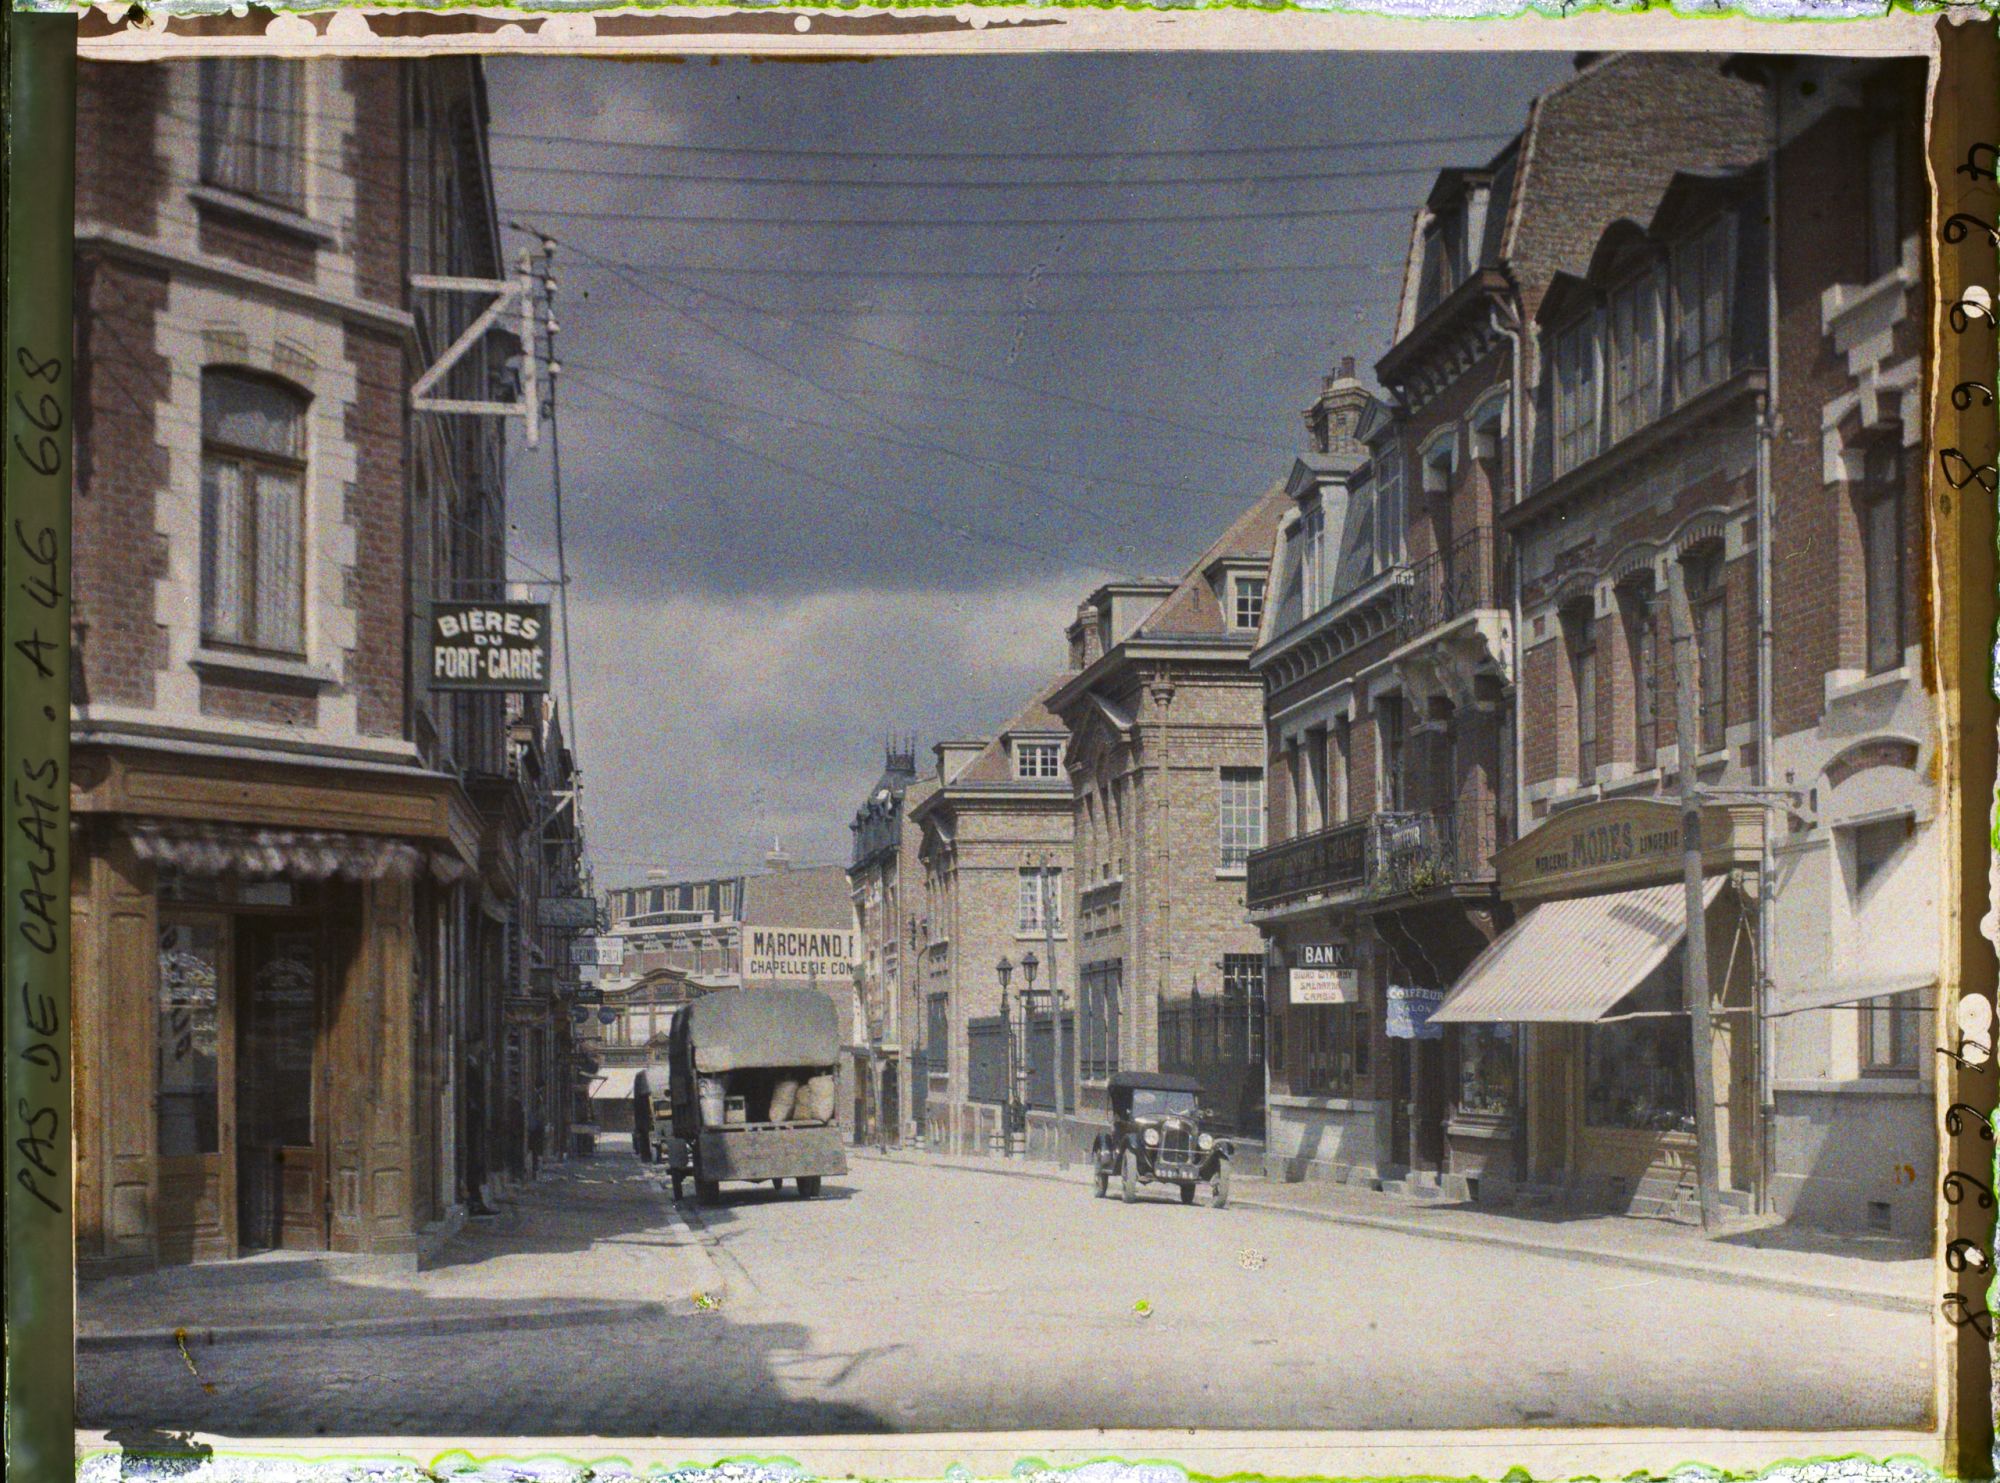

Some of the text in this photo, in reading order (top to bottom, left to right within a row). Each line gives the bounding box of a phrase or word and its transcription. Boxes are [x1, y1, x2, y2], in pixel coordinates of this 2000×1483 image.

[14, 345, 63, 477] 668
[437, 607, 541, 640] BIÈRES
[473, 633, 503, 646] DU
[14, 627, 60, 679] A
[1572, 822, 1632, 867] MODES
[750, 960, 826, 975] CHAPELLEIE
[1305, 946, 1345, 964] BANK
[20, 981, 62, 1083] DE
[16, 1097, 64, 1215] PAS
